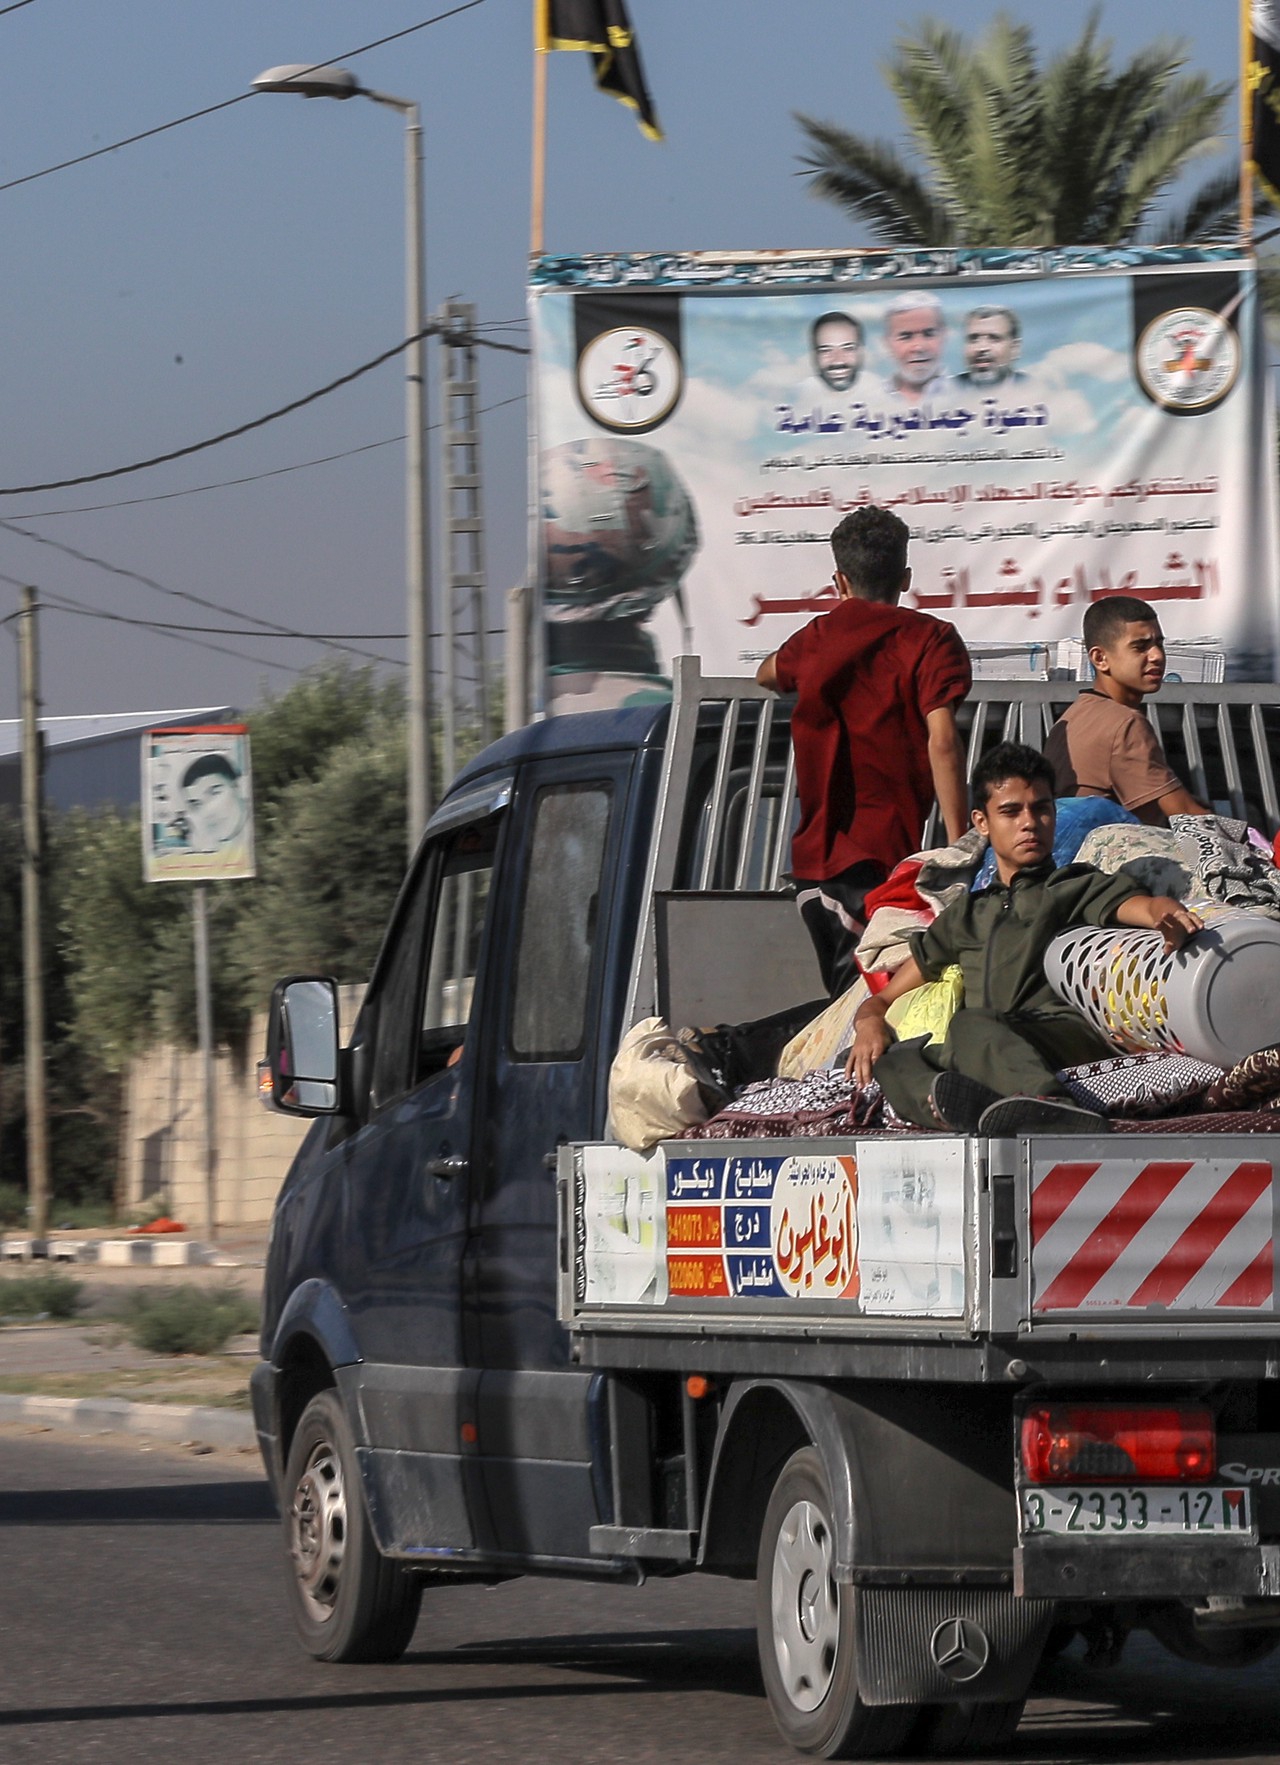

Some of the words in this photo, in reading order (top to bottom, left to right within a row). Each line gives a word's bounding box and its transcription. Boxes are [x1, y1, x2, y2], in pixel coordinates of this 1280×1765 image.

[774, 404, 849, 435] عامة
[850, 401, 977, 441] جماهيرية
[982, 398, 1049, 436] دعوة
[734, 486, 832, 518] فلسطين
[671, 1160, 715, 1198] ديكور
[734, 1160, 772, 1198] مطابخ
[734, 1211, 761, 1243] درج
[736, 1259, 773, 1294] مغاسل
